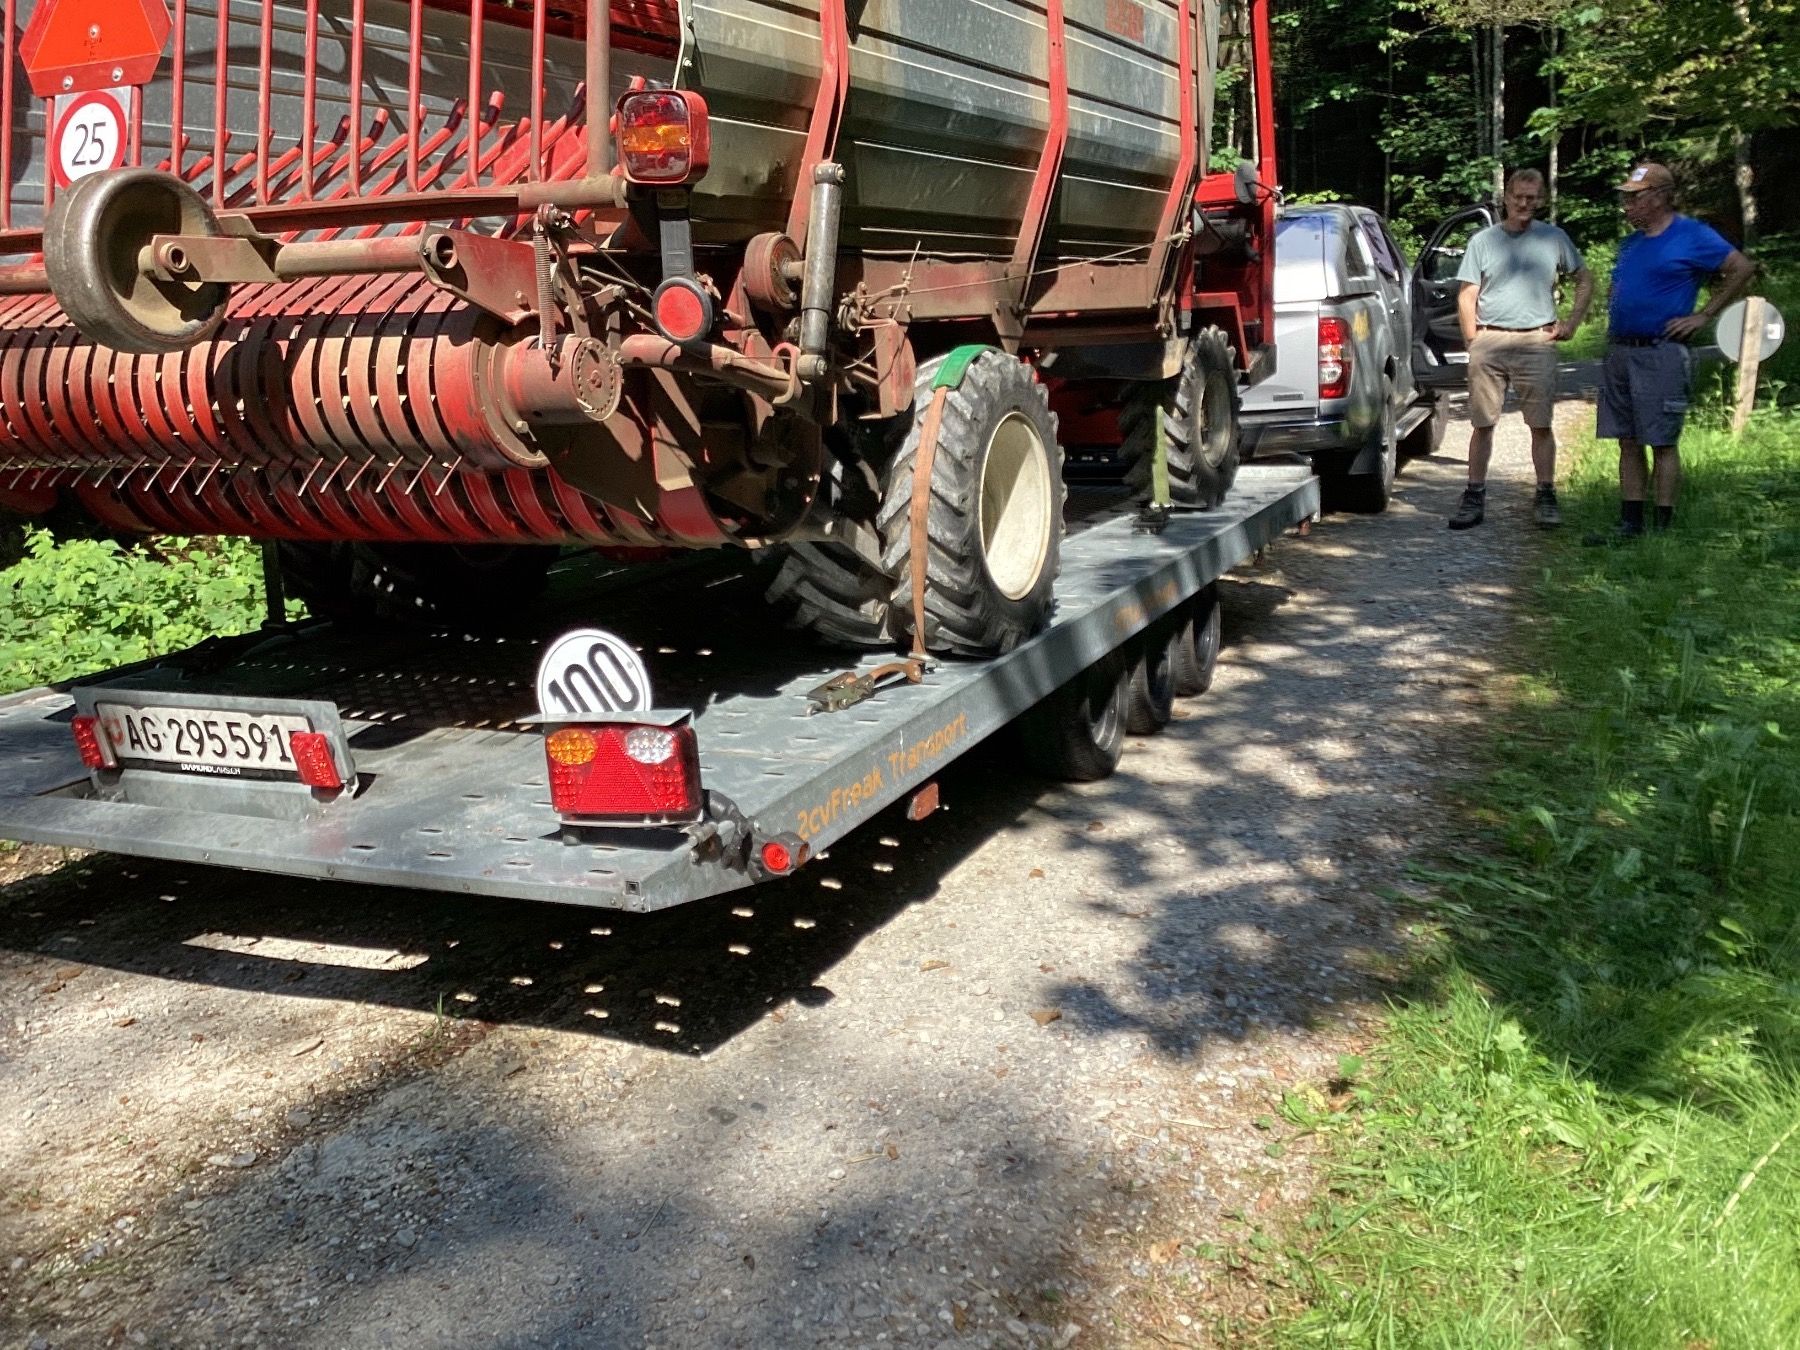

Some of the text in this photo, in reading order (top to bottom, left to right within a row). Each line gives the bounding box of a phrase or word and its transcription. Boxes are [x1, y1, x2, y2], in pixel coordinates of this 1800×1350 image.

[72, 122, 106, 166] 25
[548, 643, 640, 713] 100
[889, 712, 967, 781] Transport
